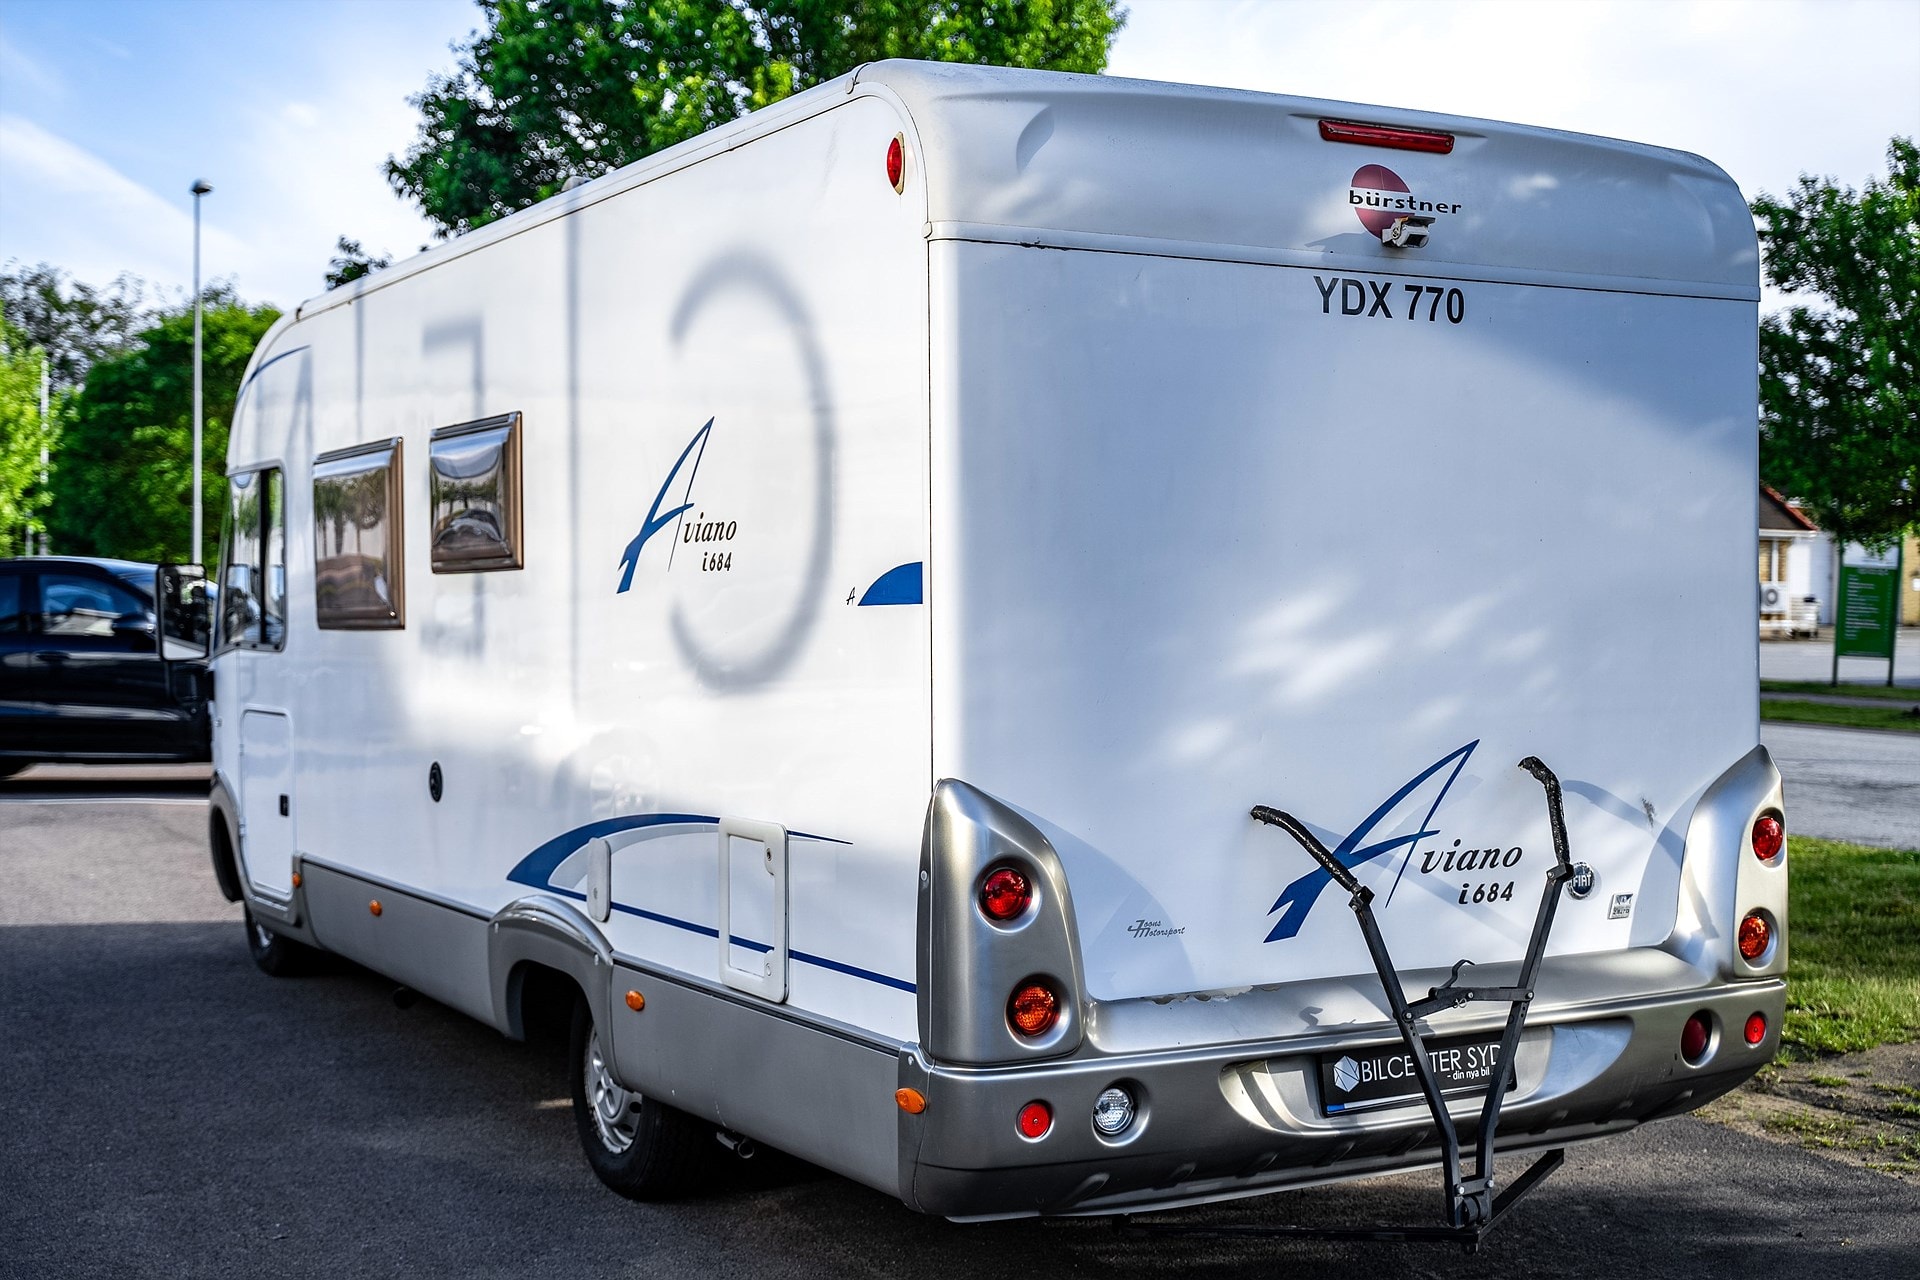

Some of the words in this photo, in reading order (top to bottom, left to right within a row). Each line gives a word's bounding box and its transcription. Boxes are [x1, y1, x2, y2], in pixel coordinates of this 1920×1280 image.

[1349, 190, 1462, 214] bürstner
[1313, 276, 1393, 319] YDX
[1404, 284, 1465, 324] 770
[616, 416, 737, 594] Aviano
[702, 551, 732, 571] i684
[1263, 739, 1522, 943] Aviano
[1573, 874, 1591, 887] FIAT
[1458, 881, 1514, 905] i684
[1361, 1050, 1461, 1082] BILCETER
[1453, 1070, 1465, 1081] din
[1466, 1069, 1480, 1080] nya
